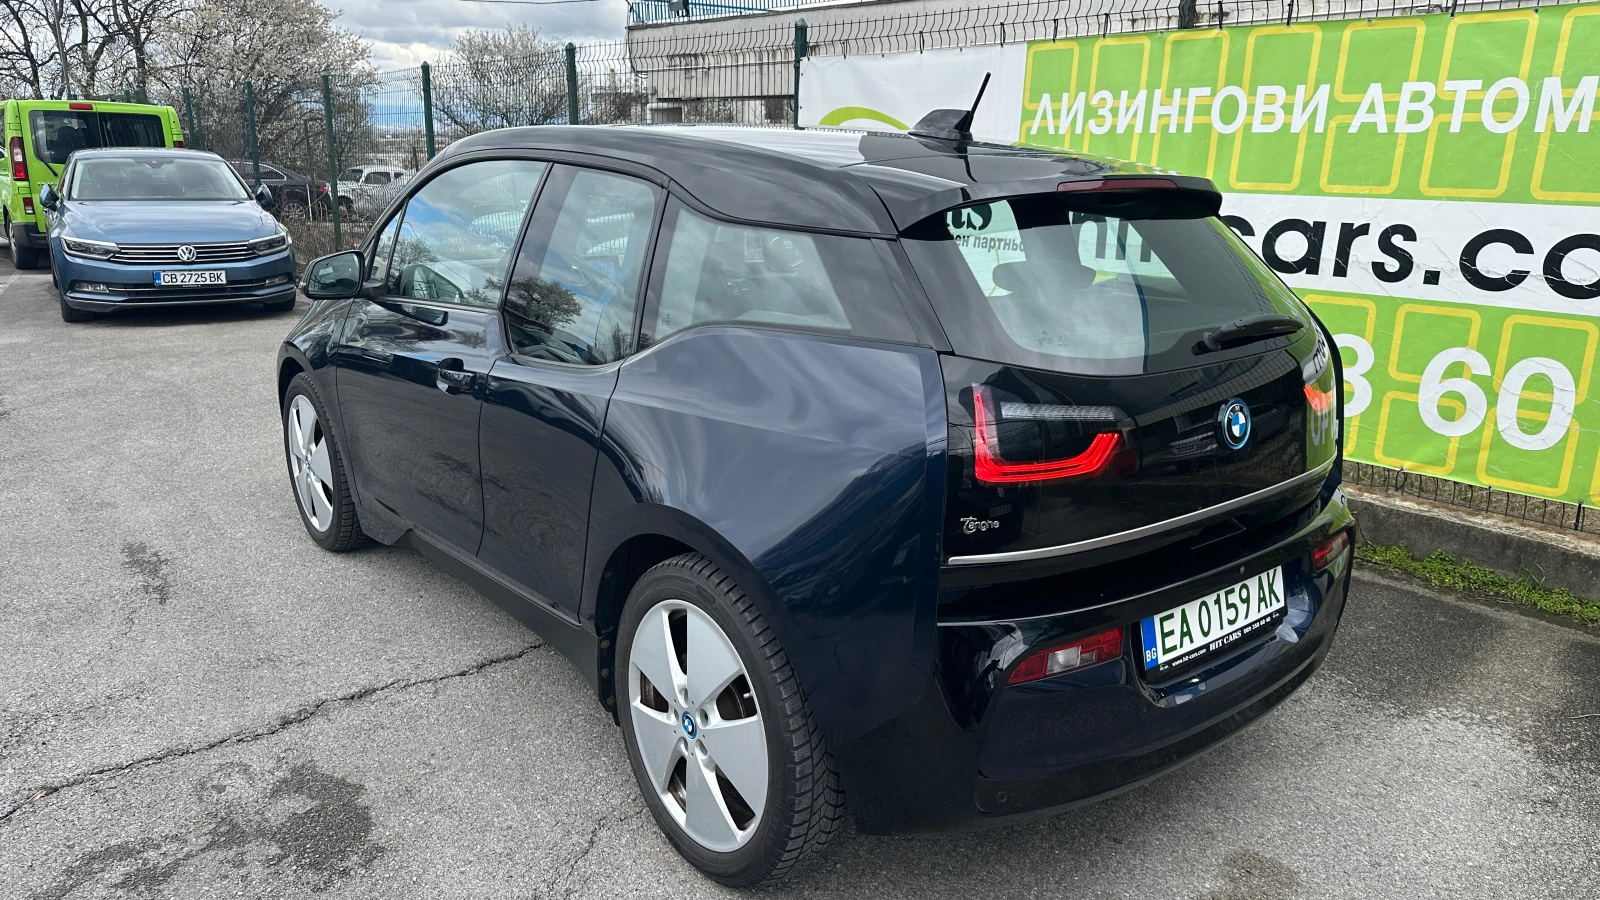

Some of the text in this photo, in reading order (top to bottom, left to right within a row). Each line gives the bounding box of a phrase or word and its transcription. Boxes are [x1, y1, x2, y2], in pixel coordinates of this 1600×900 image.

[1030, 75, 1600, 135] ЛИЗИНГОВИ АВТОМ
[163, 273, 178, 284] CB
[180, 273, 207, 283] 2725
[209, 272, 223, 282] BK
[1418, 346, 1576, 450] 60
[1159, 568, 1281, 656] EA 0159 AK
[1145, 647, 1157, 663] BG
[1209, 639, 1223, 651] HIT
[1223, 629, 1242, 645] CARS
